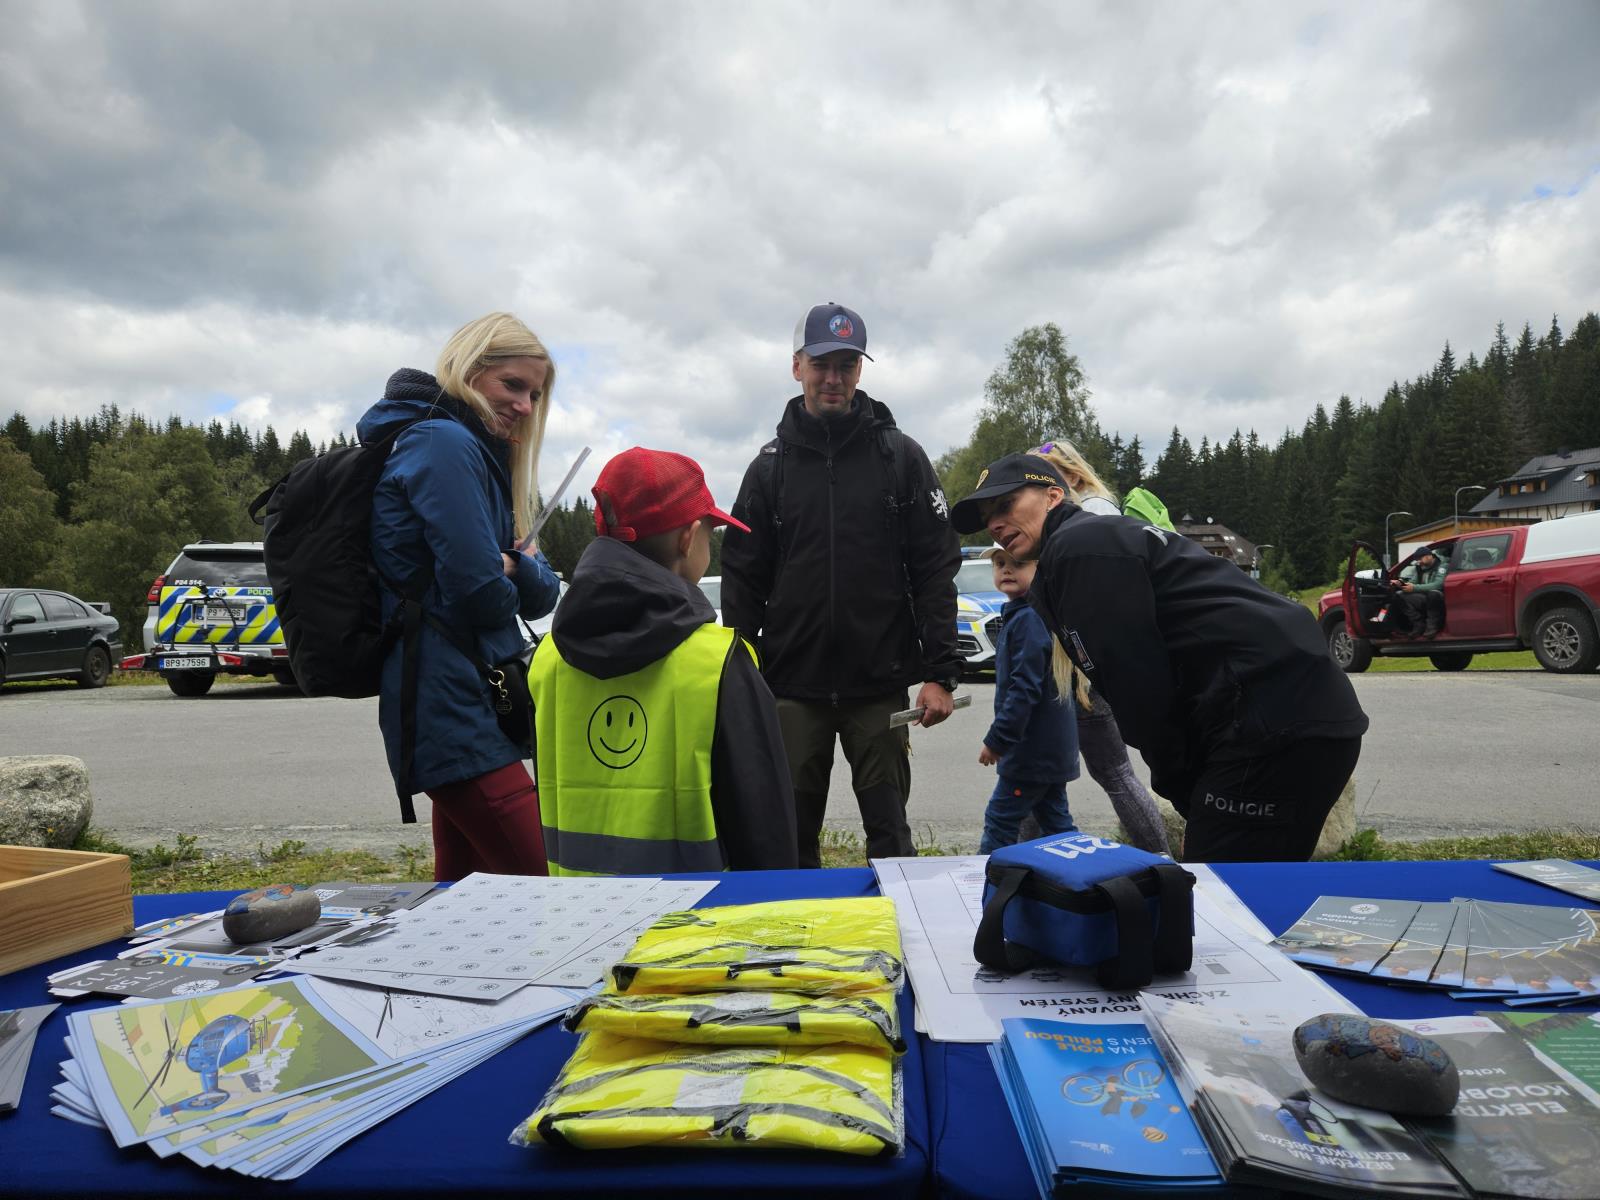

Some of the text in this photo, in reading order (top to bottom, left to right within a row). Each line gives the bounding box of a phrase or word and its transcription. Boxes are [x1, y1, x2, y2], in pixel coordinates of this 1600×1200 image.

[1024, 473, 1057, 486] POLICIE
[247, 588, 273, 596] POLICI
[164, 658, 206, 667] 8P9 7596
[1204, 792, 1277, 818] POLICIE
[1019, 998, 1098, 1009] SYSTÉM
[1024, 1031, 1154, 1046] JEN S PŘILBOU
[1056, 1042, 1136, 1055] NA KOLE
